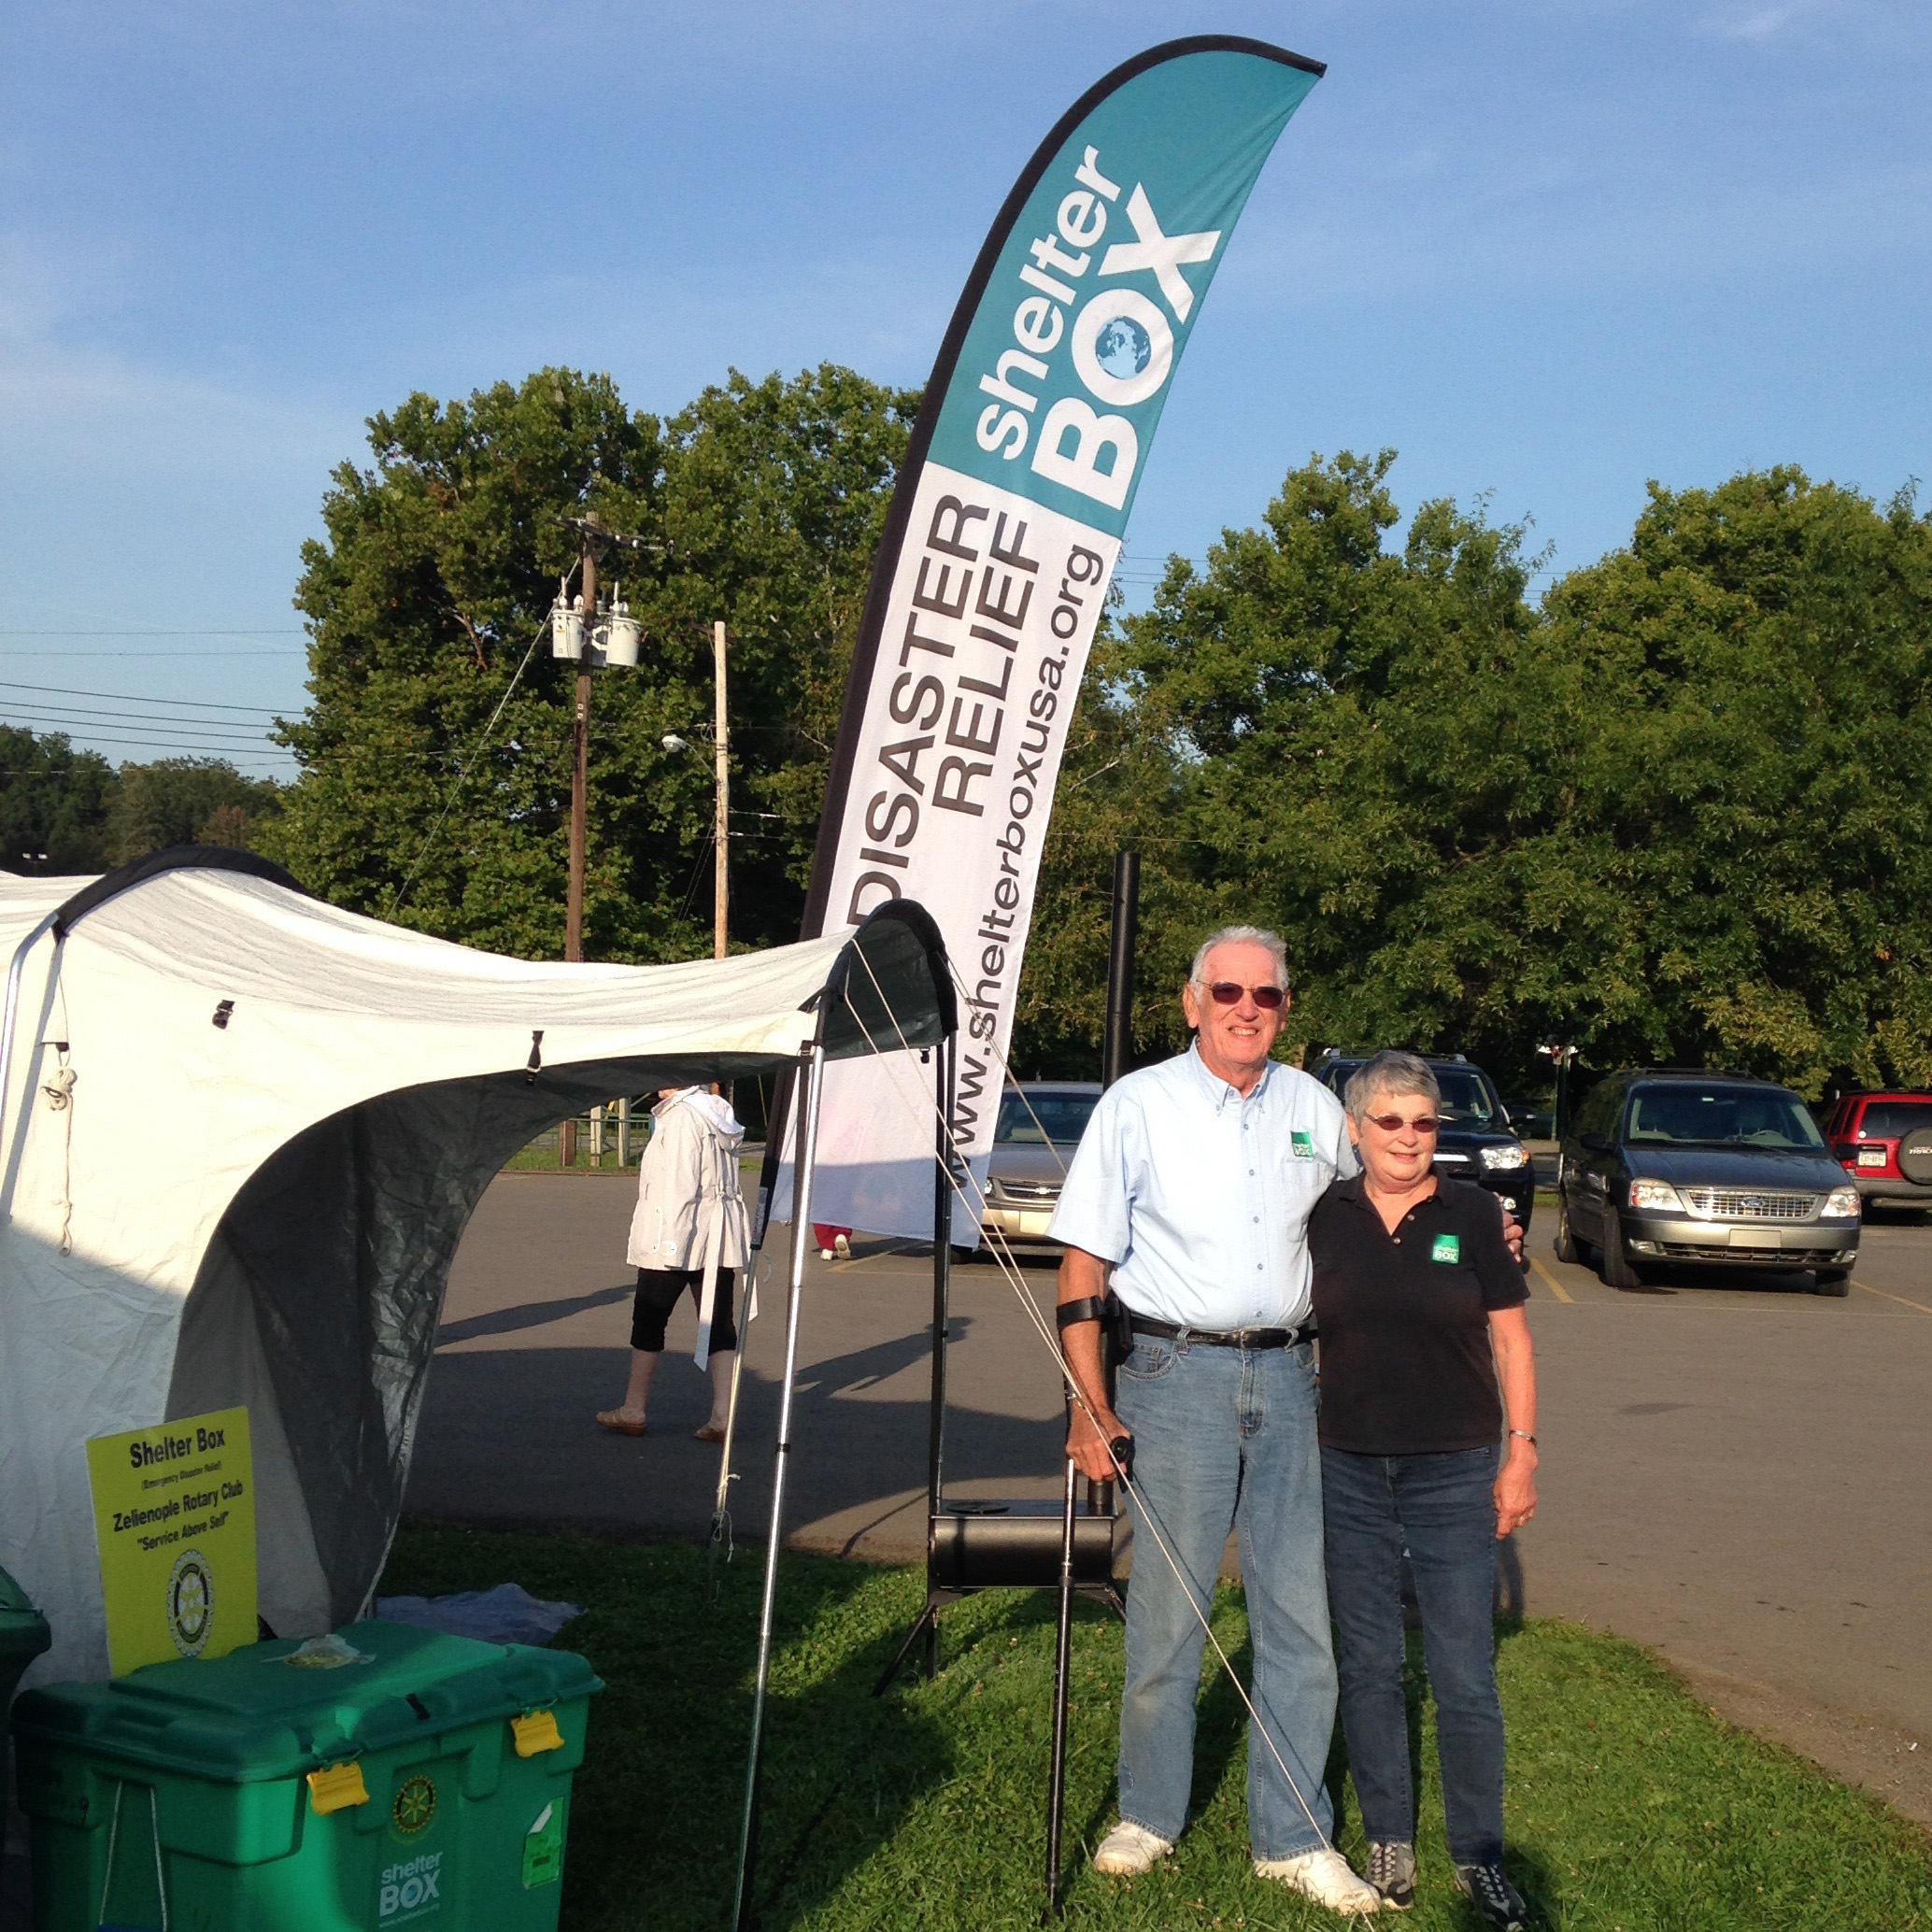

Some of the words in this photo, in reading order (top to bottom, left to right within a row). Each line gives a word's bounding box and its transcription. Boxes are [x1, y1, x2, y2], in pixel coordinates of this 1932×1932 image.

[975, 144, 1121, 461] shelter
[1030, 181, 1222, 511] BOX
[931, 511, 1040, 817] RELIEF
[845, 494, 990, 928] DISASTER
[129, 1436, 192, 1469] Shelter
[196, 1428, 226, 1453] Box
[112, 1499, 180, 1532] Zelienople
[182, 1489, 219, 1512] Rotary
[220, 1479, 243, 1499] Club
[181, 1522, 207, 1539] Above
[378, 1868, 442, 1917] BOX
[381, 1851, 444, 1884] shelter
